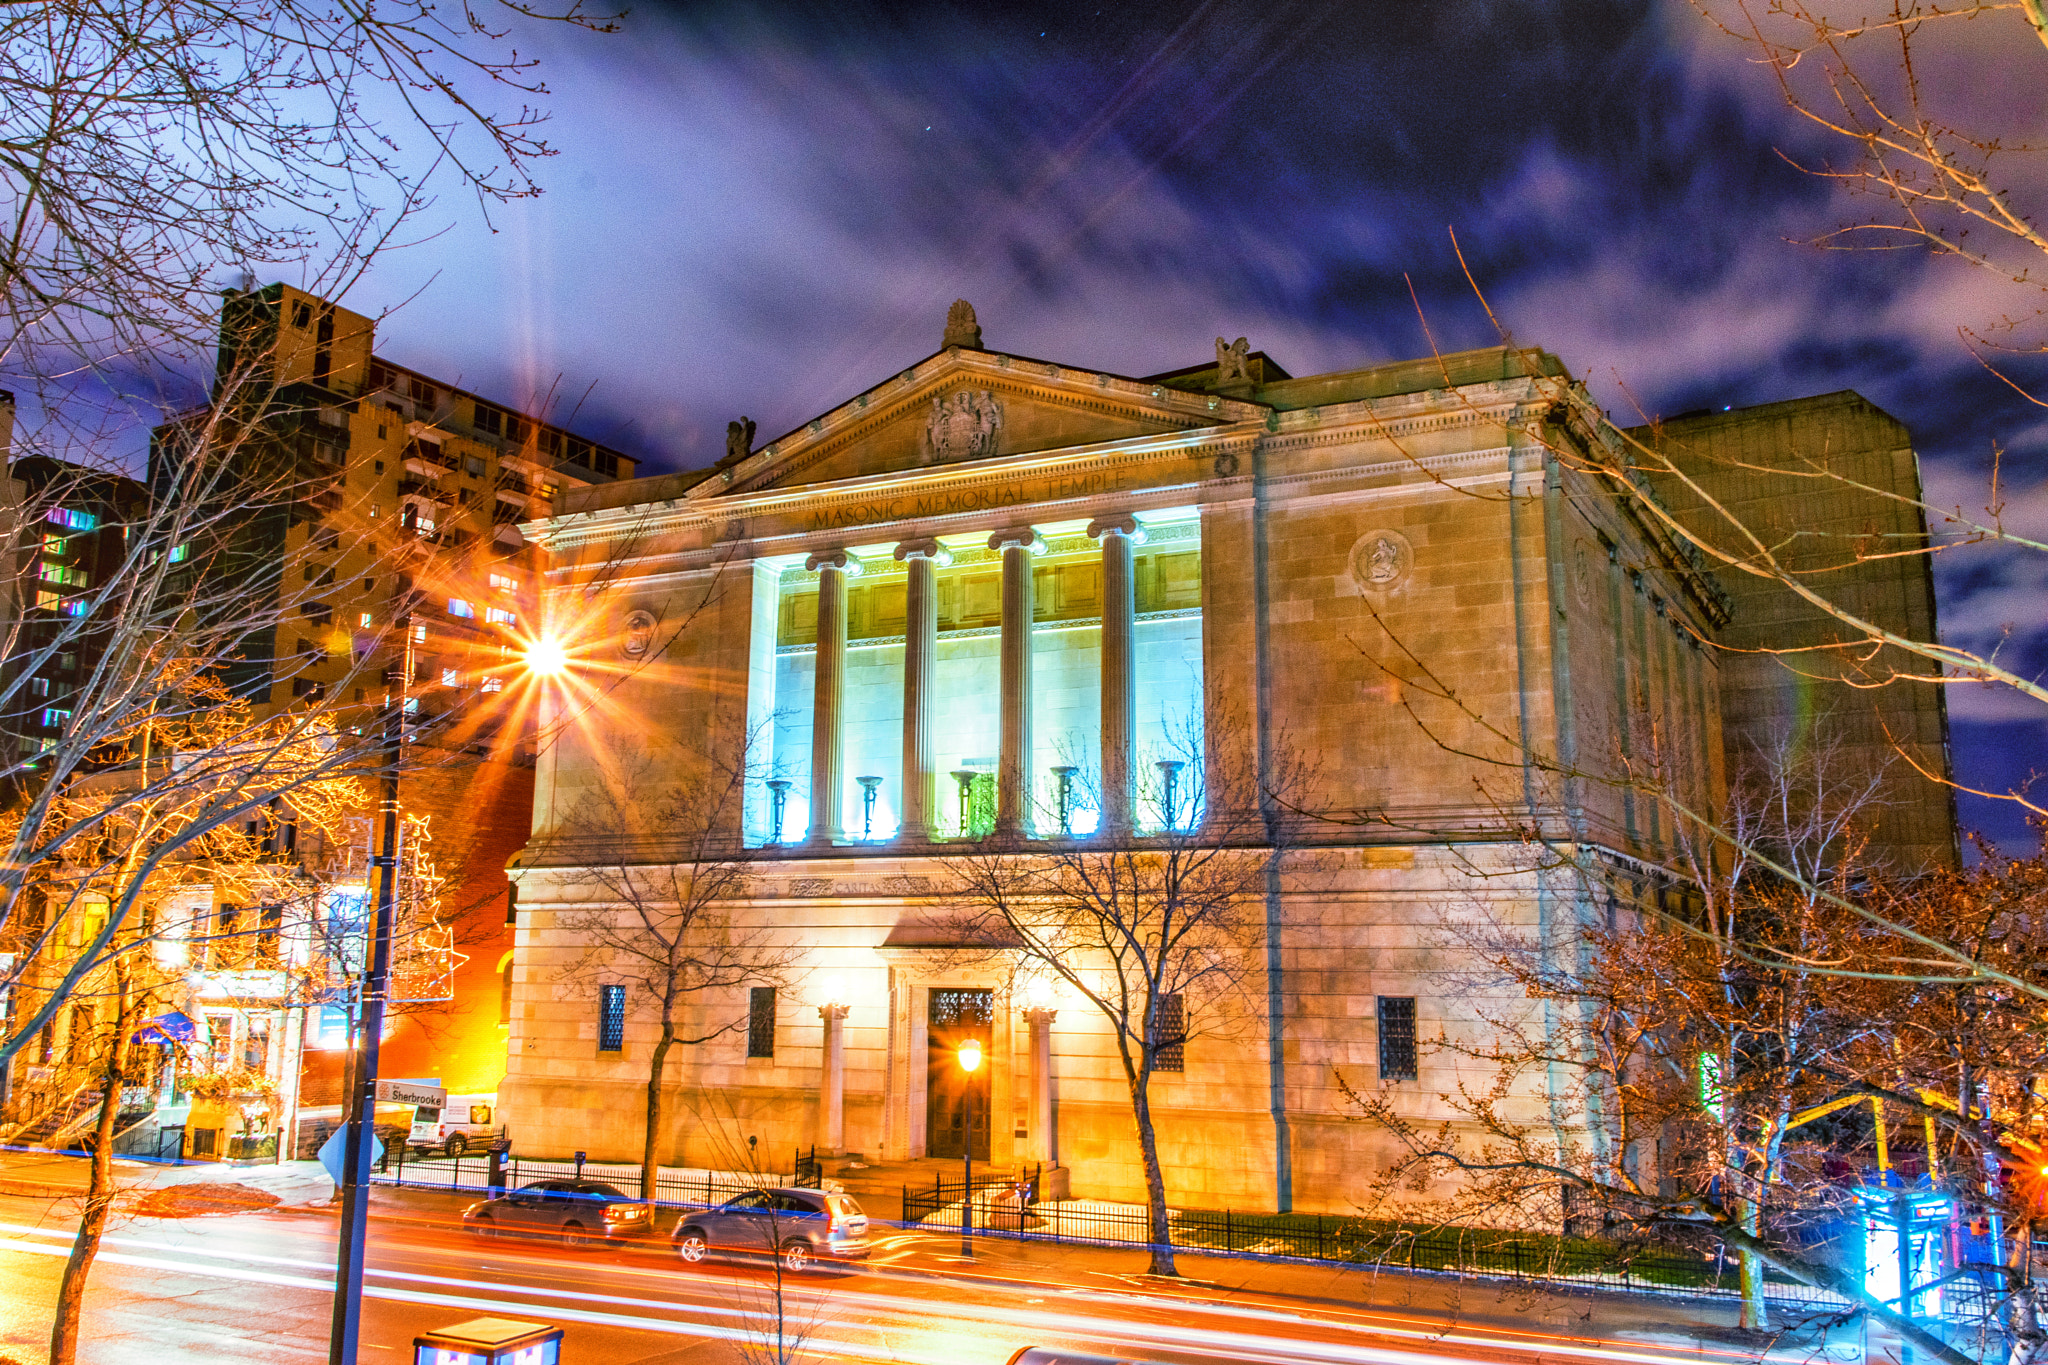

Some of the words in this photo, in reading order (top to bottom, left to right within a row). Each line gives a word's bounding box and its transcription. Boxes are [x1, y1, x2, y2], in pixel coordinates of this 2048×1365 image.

[814, 500, 904, 528] MASONIC
[916, 484, 1030, 515] MEMORIAL
[1043, 470, 1127, 498] TEMPLE
[835, 881, 882, 894] CARITAS
[392, 1090, 442, 1106] Sherbrooke
